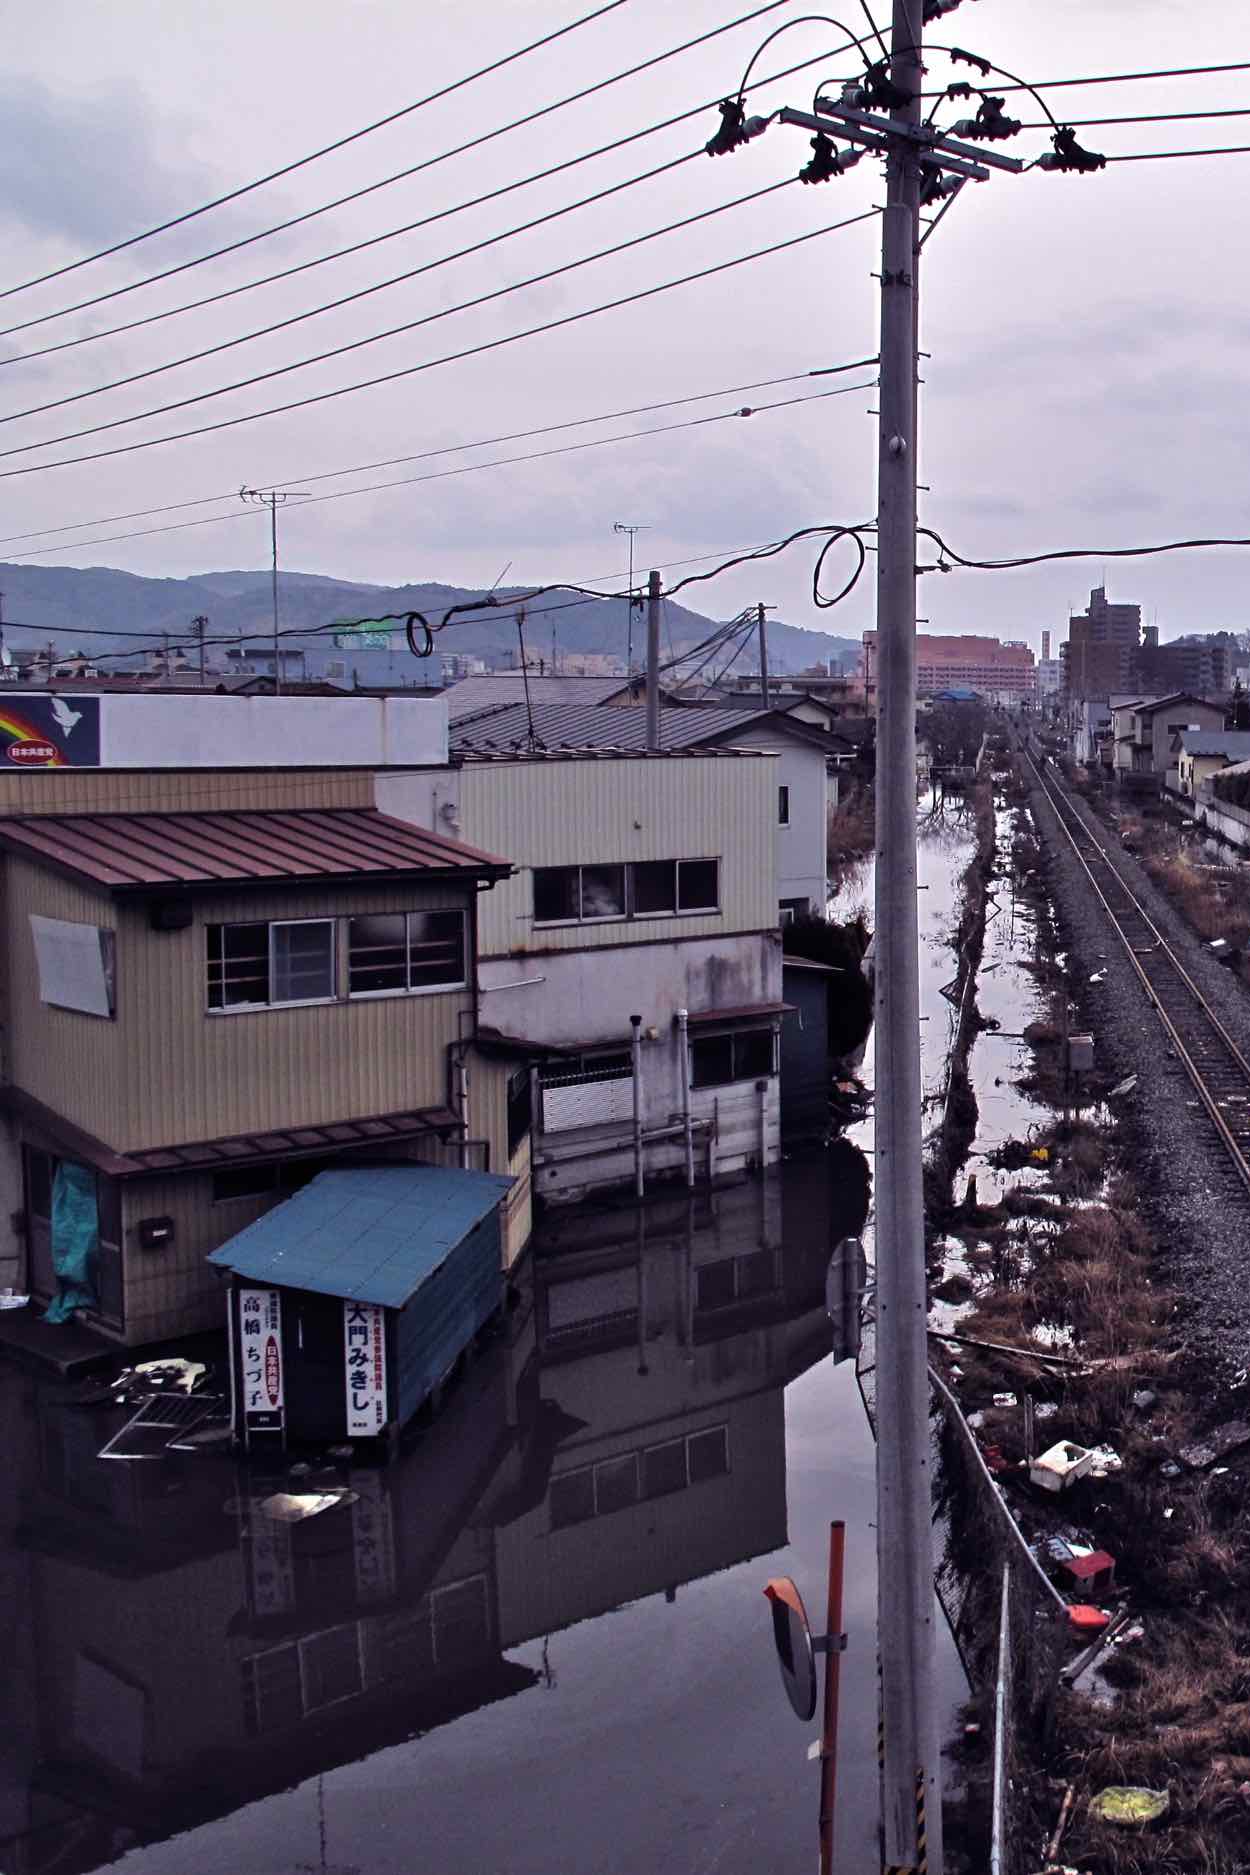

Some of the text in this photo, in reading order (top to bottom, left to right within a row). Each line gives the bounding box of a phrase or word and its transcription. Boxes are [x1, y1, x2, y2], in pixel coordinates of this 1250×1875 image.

[244, 1296, 263, 1406] 高橋ちづ子
[266, 1346, 280, 1396] 日本共産党
[347, 1303, 369, 1411] 大門みきし
